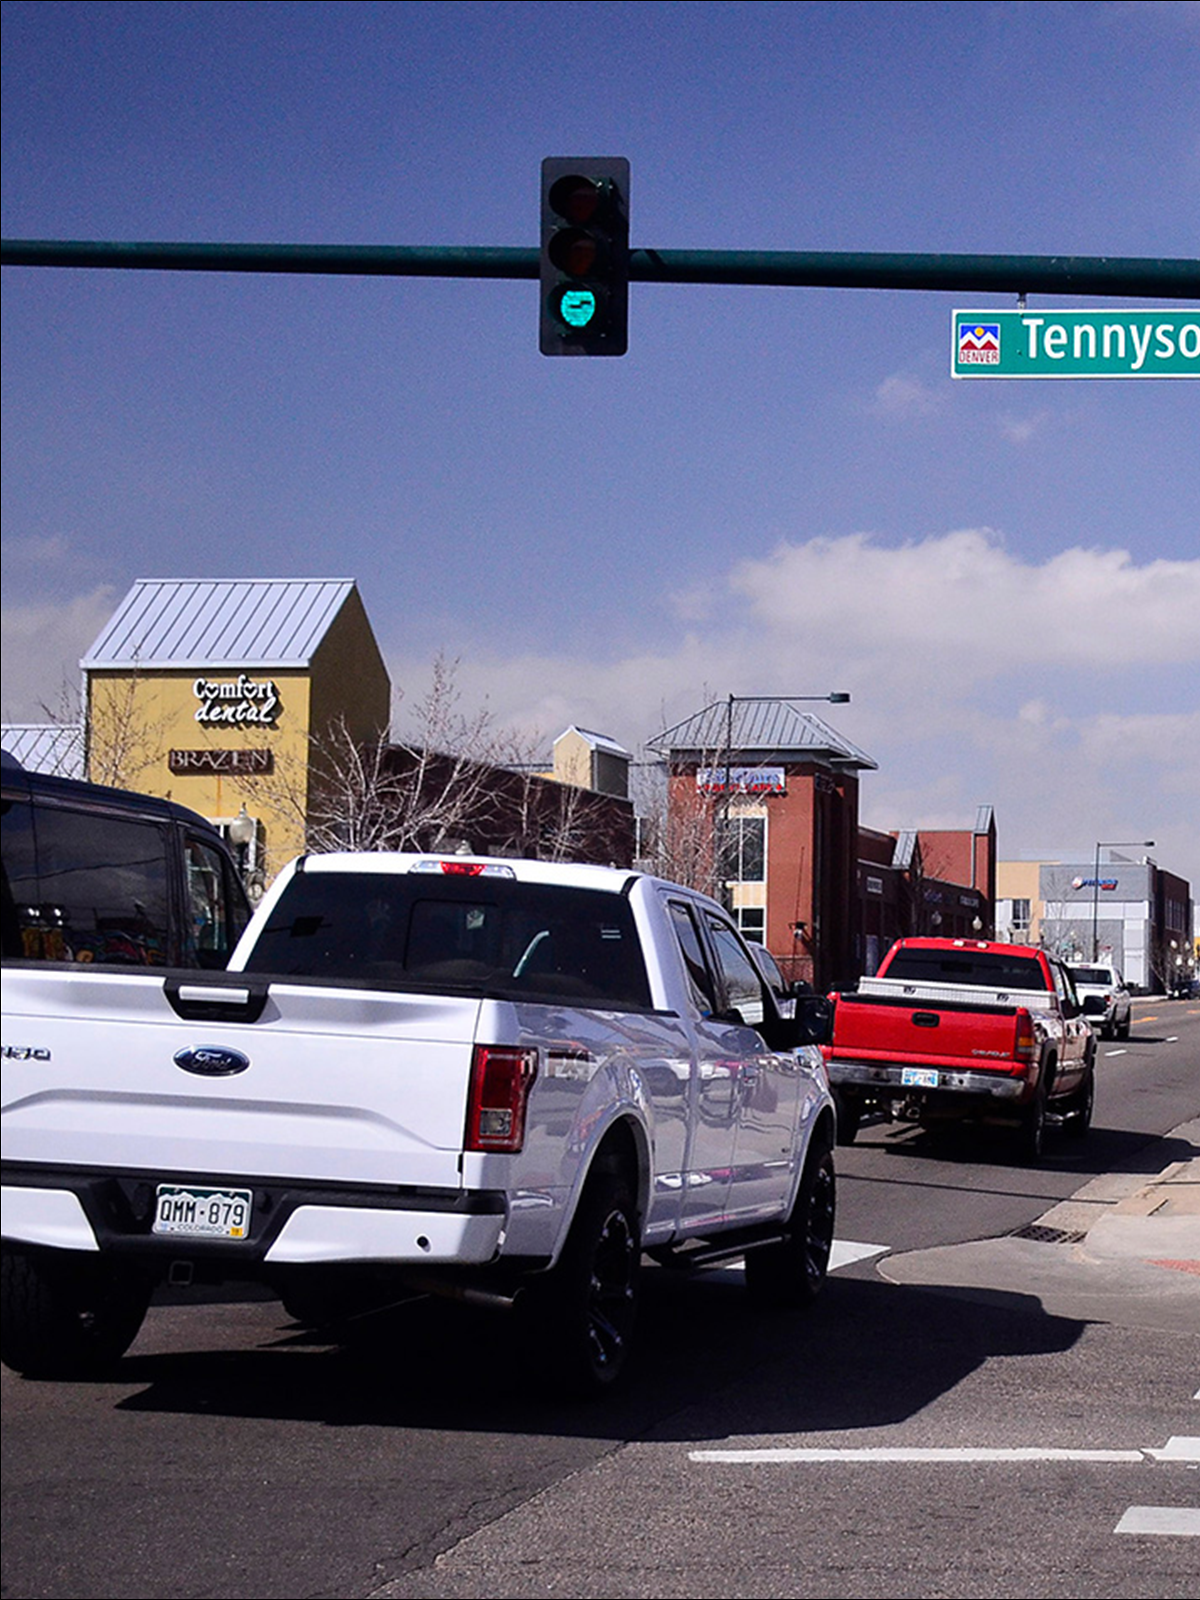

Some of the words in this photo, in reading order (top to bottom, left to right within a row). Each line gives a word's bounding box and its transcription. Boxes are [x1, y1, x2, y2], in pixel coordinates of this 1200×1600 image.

[958, 350, 999, 363] DENVER
[193, 674, 274, 699] Comfort
[194, 696, 276, 722] dental
